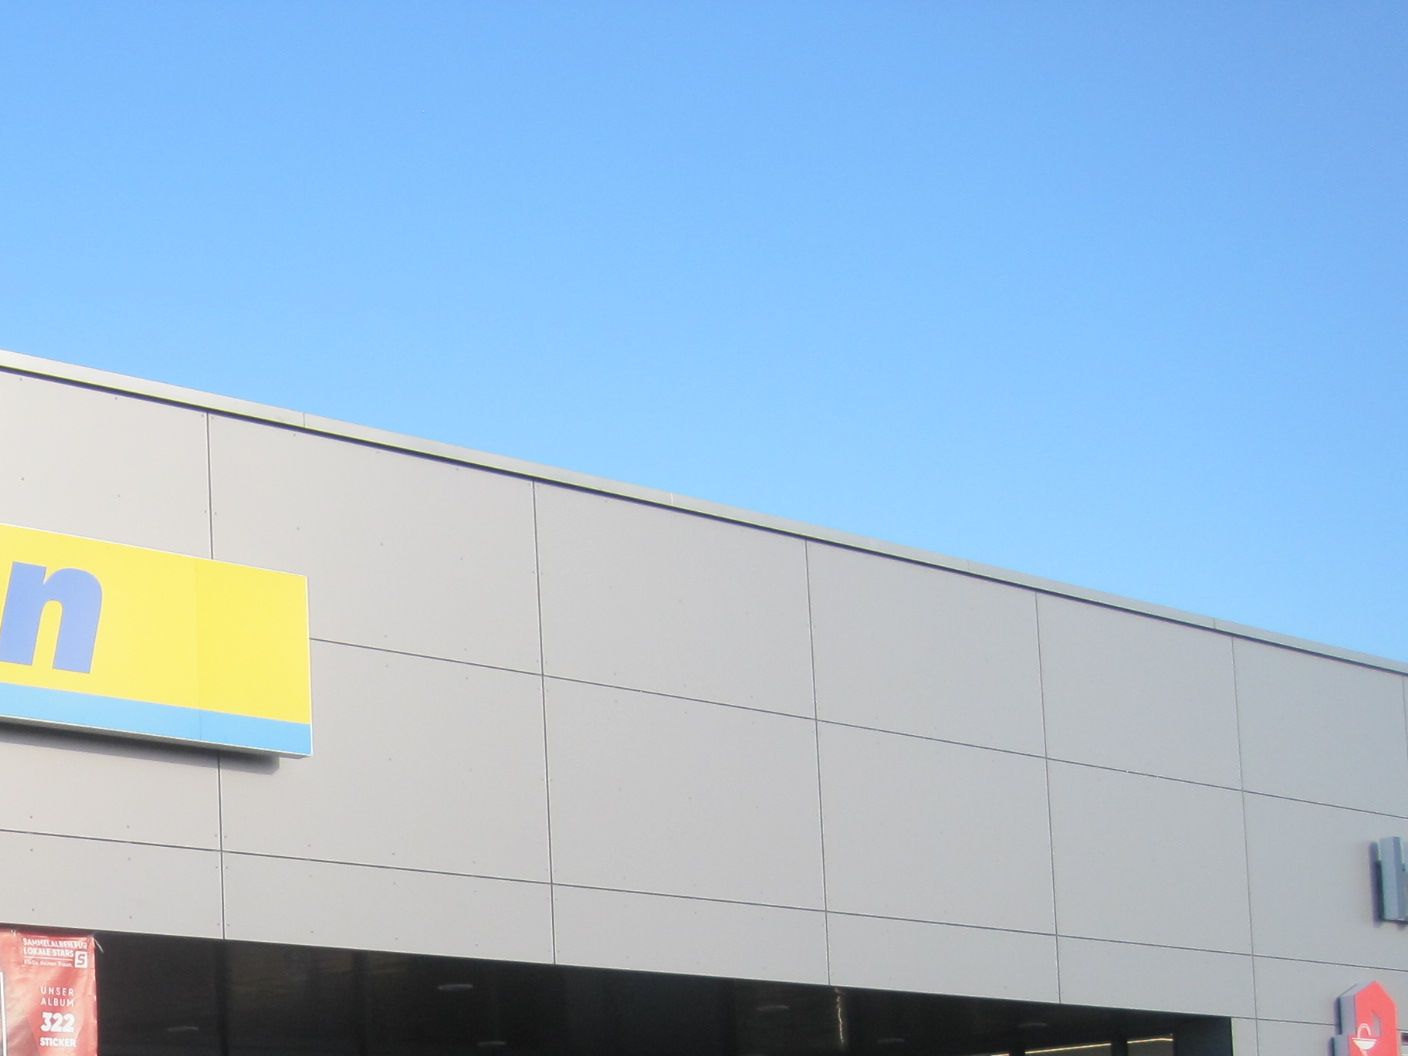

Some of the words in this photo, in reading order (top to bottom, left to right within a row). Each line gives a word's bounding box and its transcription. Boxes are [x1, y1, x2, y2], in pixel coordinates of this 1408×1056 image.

[23, 947, 51, 956] LOKALE
[52, 948, 74, 957] STARS
[40, 986, 74, 996] UNSER
[40, 997, 74, 1007] ALBUM
[40, 1012, 75, 1033] 322
[39, 1036, 76, 1048] STICKER
